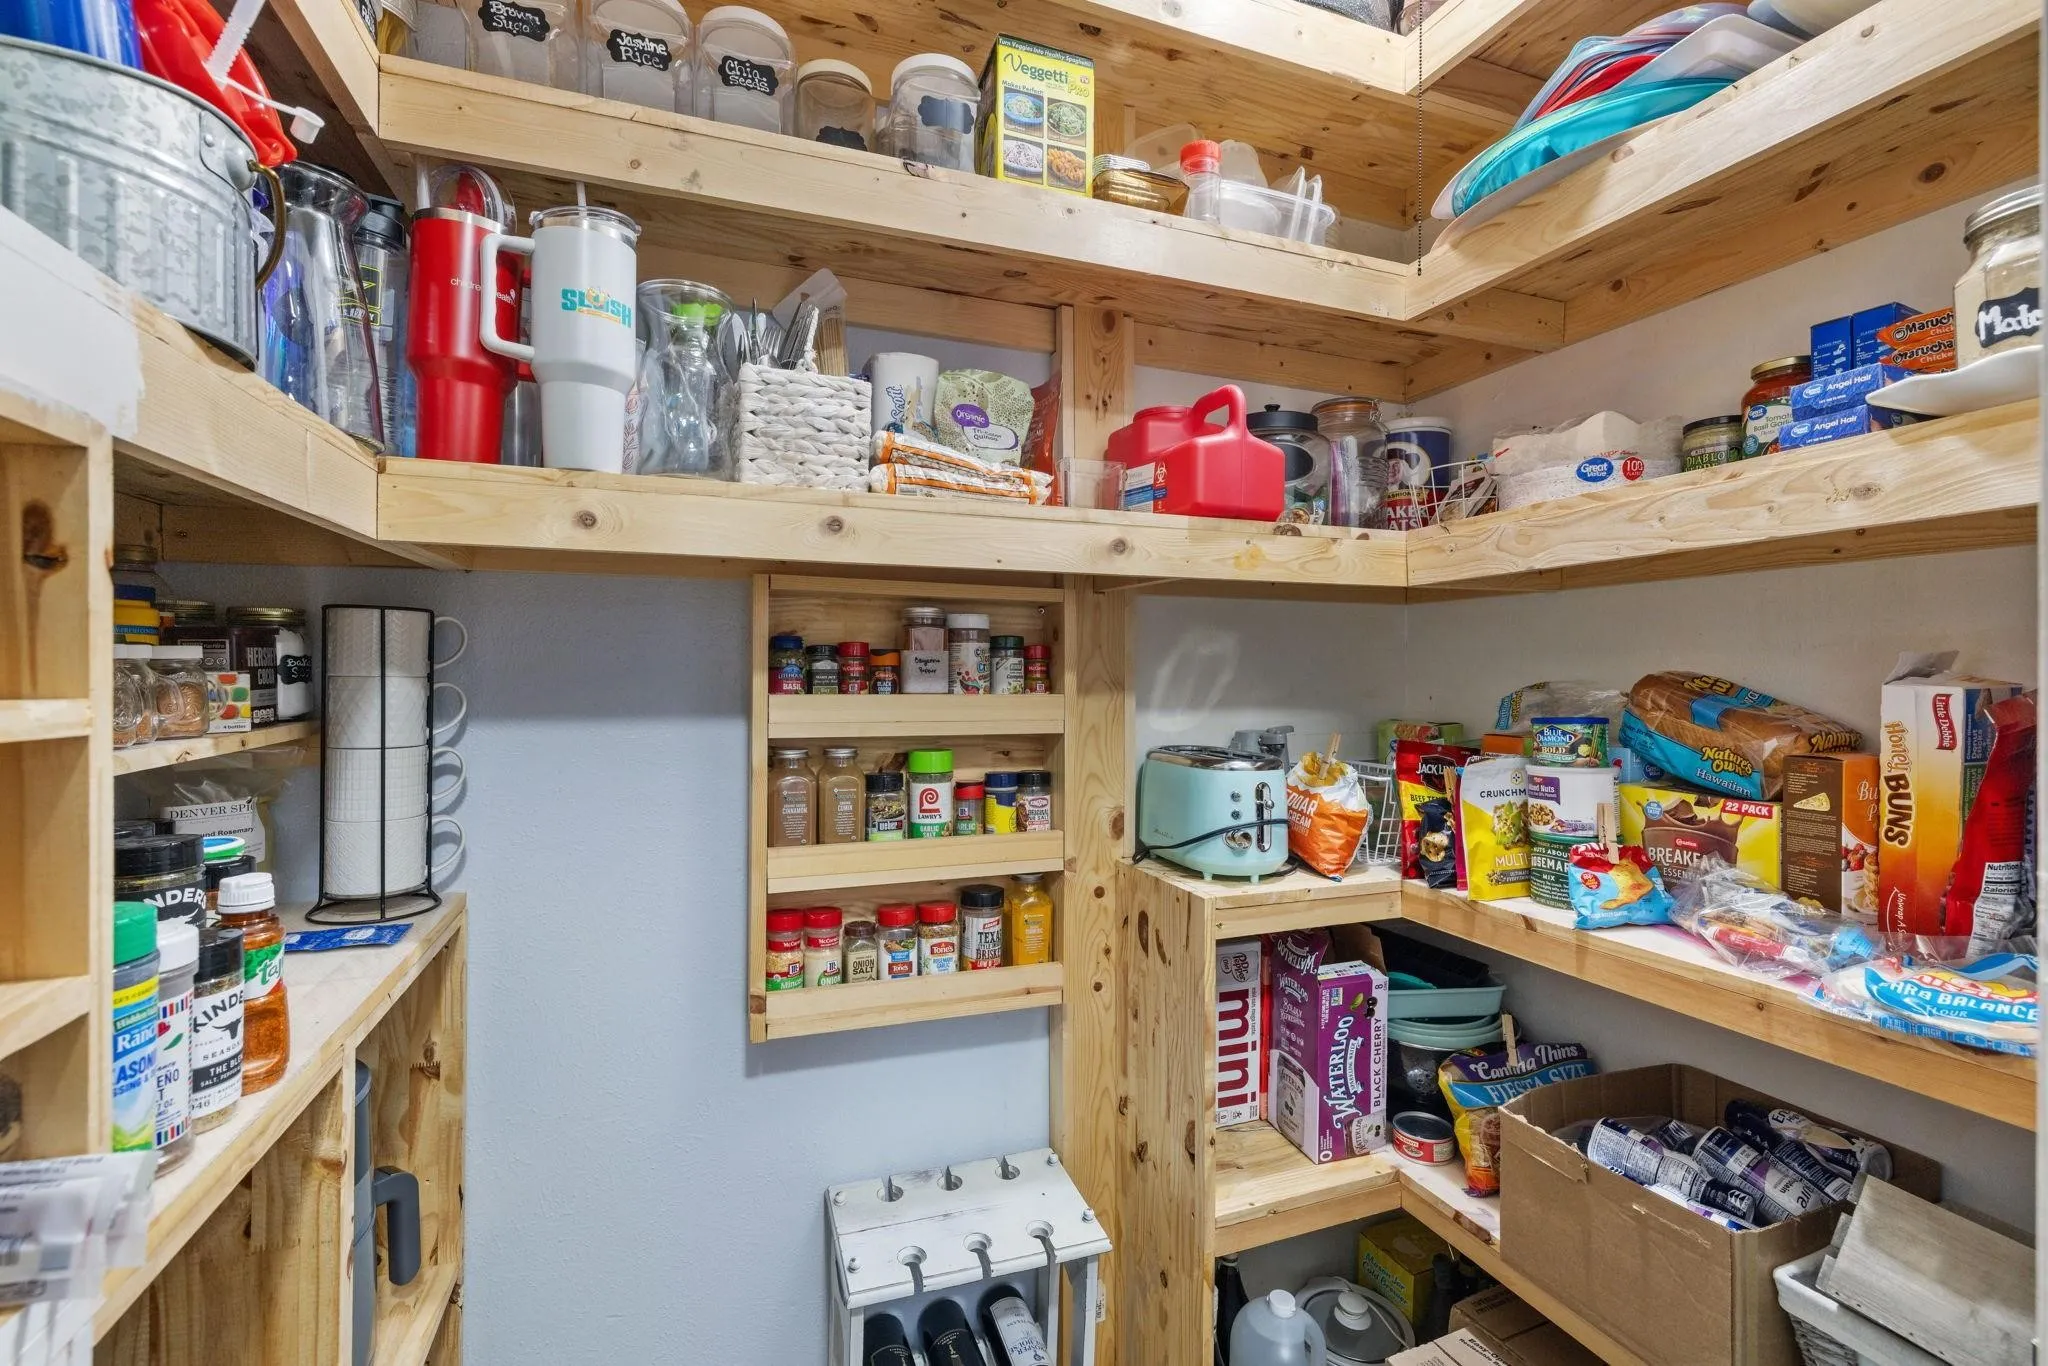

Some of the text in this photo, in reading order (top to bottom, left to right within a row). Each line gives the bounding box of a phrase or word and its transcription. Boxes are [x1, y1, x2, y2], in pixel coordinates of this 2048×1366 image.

[489, 1, 540, 25] Brown
[492, 15, 536, 34] Suga
[616, 33, 668, 56] Jasmine
[620, 46, 663, 68] Rice
[725, 59, 766, 81] Chia
[1004, 52, 1068, 84] Veggetti
[1067, 83, 1090, 98] PRO
[450, 277, 482, 291] childre
[1905, 312, 1954, 335] Maruch
[1920, 351, 1954, 364] Chicke
[1826, 374, 1872, 391] Angel Hair
[955, 409, 986, 424] Organic
[1813, 416, 1857, 432] Angel Hair
[1626, 460, 1643, 471] 100
[1686, 451, 1726, 466] DIABLO
[1581, 463, 1608, 473] Great
[1388, 519, 1420, 531] ATS
[1935, 695, 1953, 748] Little Debbie
[1536, 734, 1575, 742] DIAMOND
[1541, 746, 1566, 754] BOLD
[1884, 720, 1911, 774] Honey
[1702, 746, 1753, 771] Nature's
[1416, 763, 1437, 775] JACK
[1712, 759, 1744, 777] Own
[1541, 785, 1555, 793] Nuts
[1696, 768, 1752, 797] Hawaiian
[1410, 794, 1426, 802] BEEF
[1480, 787, 1527, 799] CRUNCHM
[170, 806, 227, 819] DENVER
[1725, 802, 1770, 816] 22 PACK
[1884, 774, 1915, 848] BUNS
[217, 826, 254, 837] Rosemary
[1531, 856, 1568, 873] OSEMAR
[1542, 873, 1555, 881] MIX
[978, 931, 1002, 945] TEXA
[932, 945, 954, 954] Tone's
[976, 949, 1002, 961] BRISK
[852, 958, 875, 969] ONION
[852, 966, 874, 975] SALT
[780, 978, 803, 990] Mince
[117, 1025, 156, 1050] Ranc
[1374, 1017, 1382, 1065] CHERRY
[1218, 989, 1257, 1108] mini
[1535, 1042, 1579, 1066] Thins
[210, 1056, 243, 1076] THE BLE
[1323, 1015, 1362, 1129] WATERLOO
